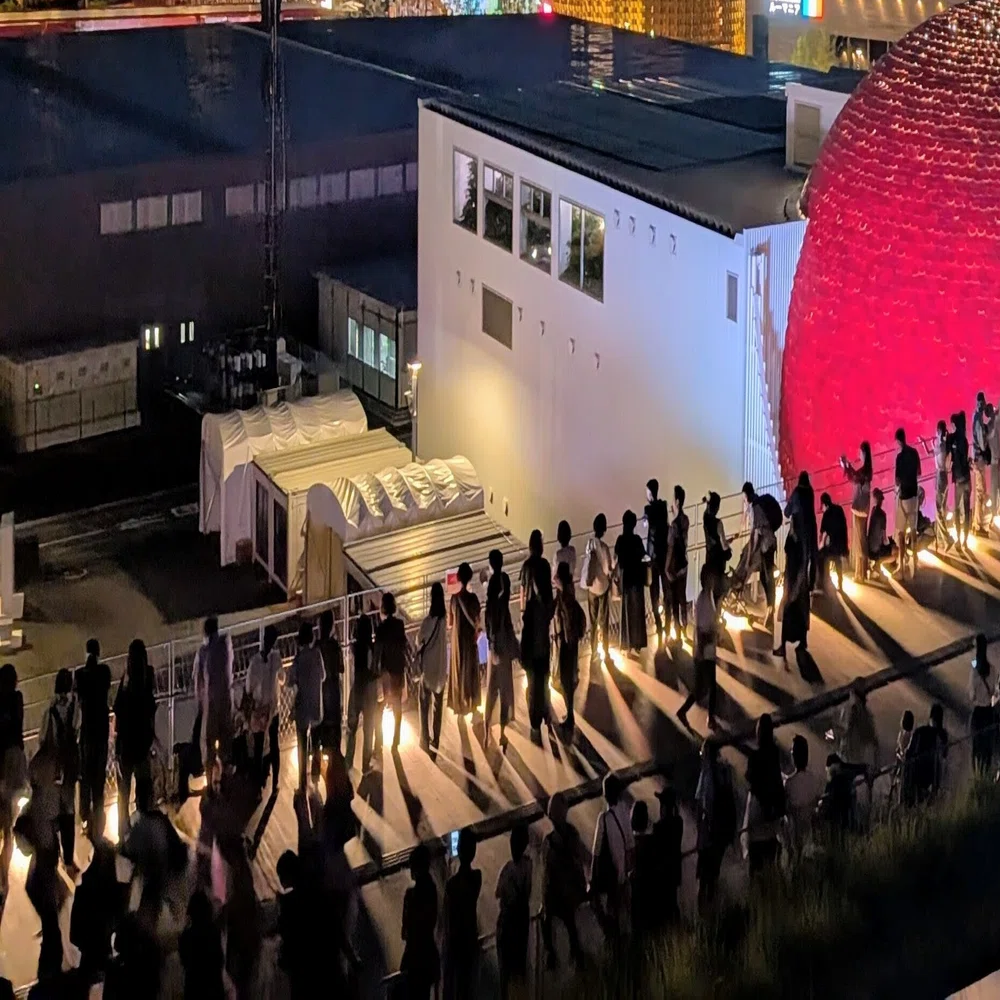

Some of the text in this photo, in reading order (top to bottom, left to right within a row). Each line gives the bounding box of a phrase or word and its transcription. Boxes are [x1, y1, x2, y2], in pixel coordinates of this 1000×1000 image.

[769, 1, 801, 16] ルーマニア
